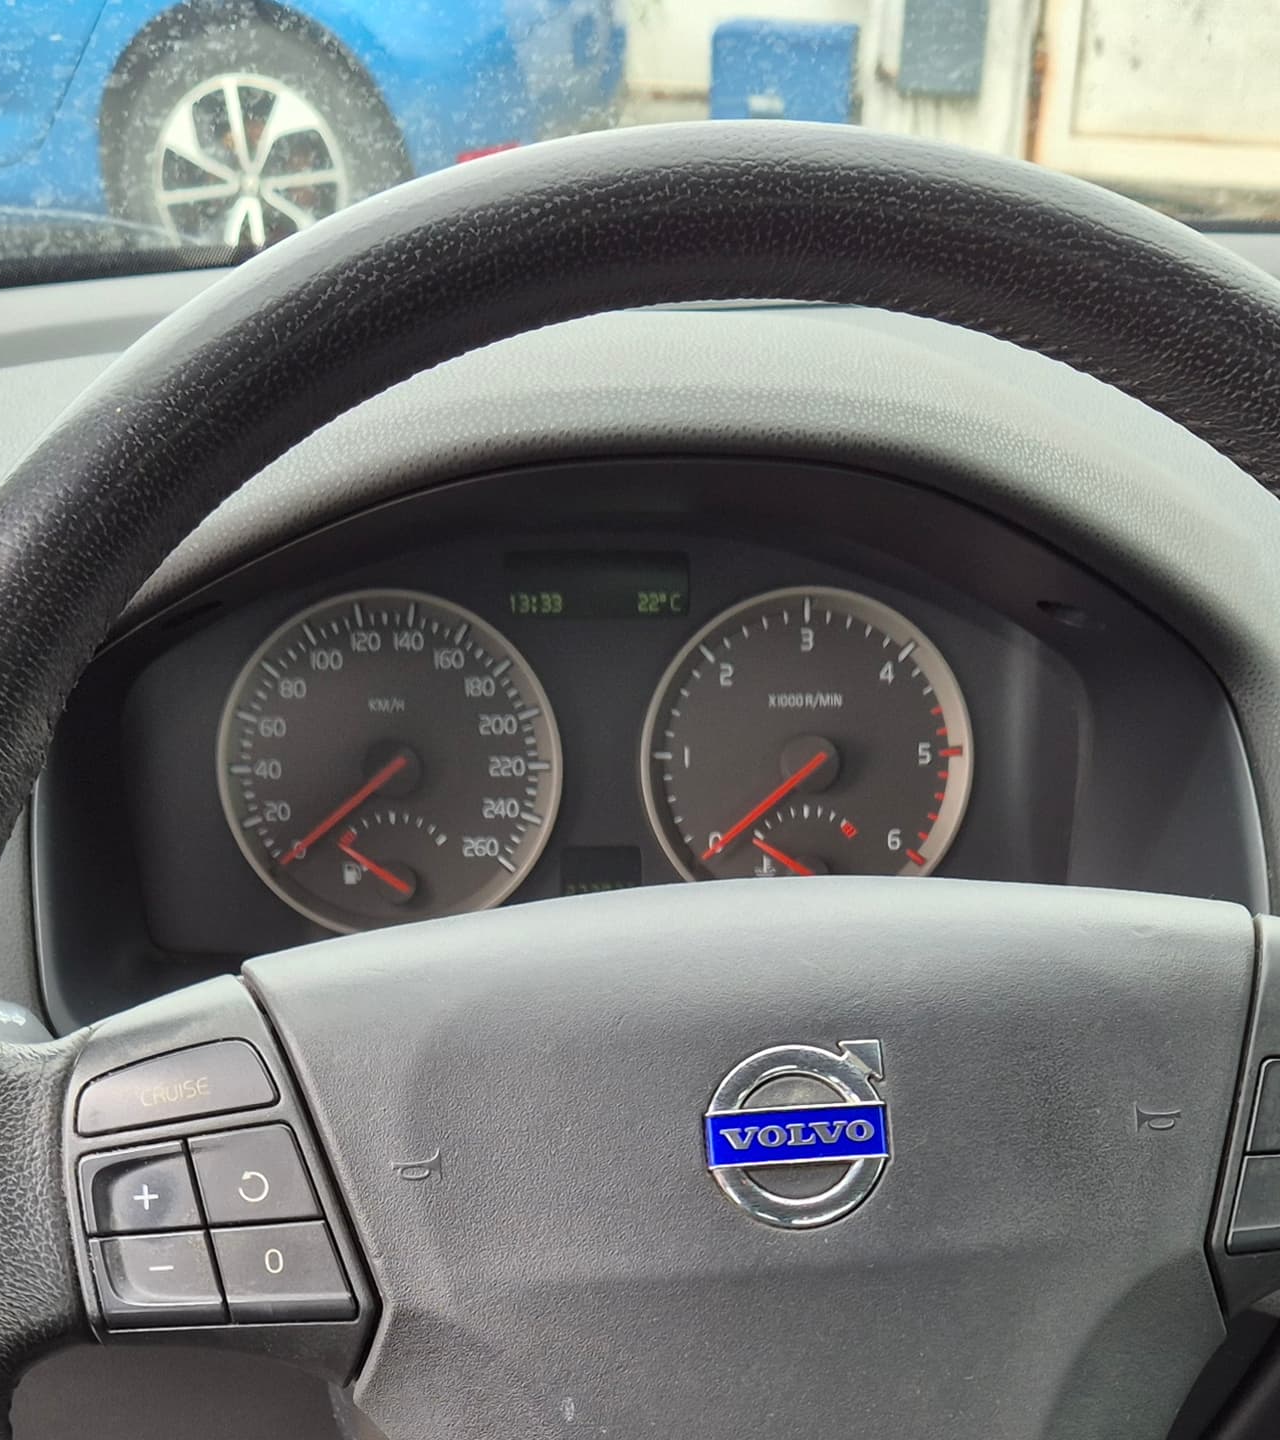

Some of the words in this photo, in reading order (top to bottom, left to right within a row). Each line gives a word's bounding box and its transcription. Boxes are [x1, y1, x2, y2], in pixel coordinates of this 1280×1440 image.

[510, 592, 563, 614] 13:33
[350, 632, 381, 652] 120
[393, 632, 424, 652] 140
[800, 628, 815, 652] 3
[310, 648, 343, 671] 100
[433, 648, 464, 669] 160
[719, 663, 735, 687] 2
[879, 662, 895, 685] 4
[279, 678, 306, 699] 80
[464, 677, 495, 697] 180
[368, 699, 405, 712] KM/H
[259, 718, 286, 738] 60
[478, 715, 518, 736] 200
[918, 743, 931, 765] 5
[255, 759, 282, 780] 40
[488, 757, 525, 777] 220
[265, 801, 291, 822] 20
[482, 799, 519, 820] 240
[463, 838, 499, 857] 260
[887, 828, 902, 852] 6
[139, 1077, 210, 1107] CRUISE
[719, 1119, 875, 1150] VOLVO
